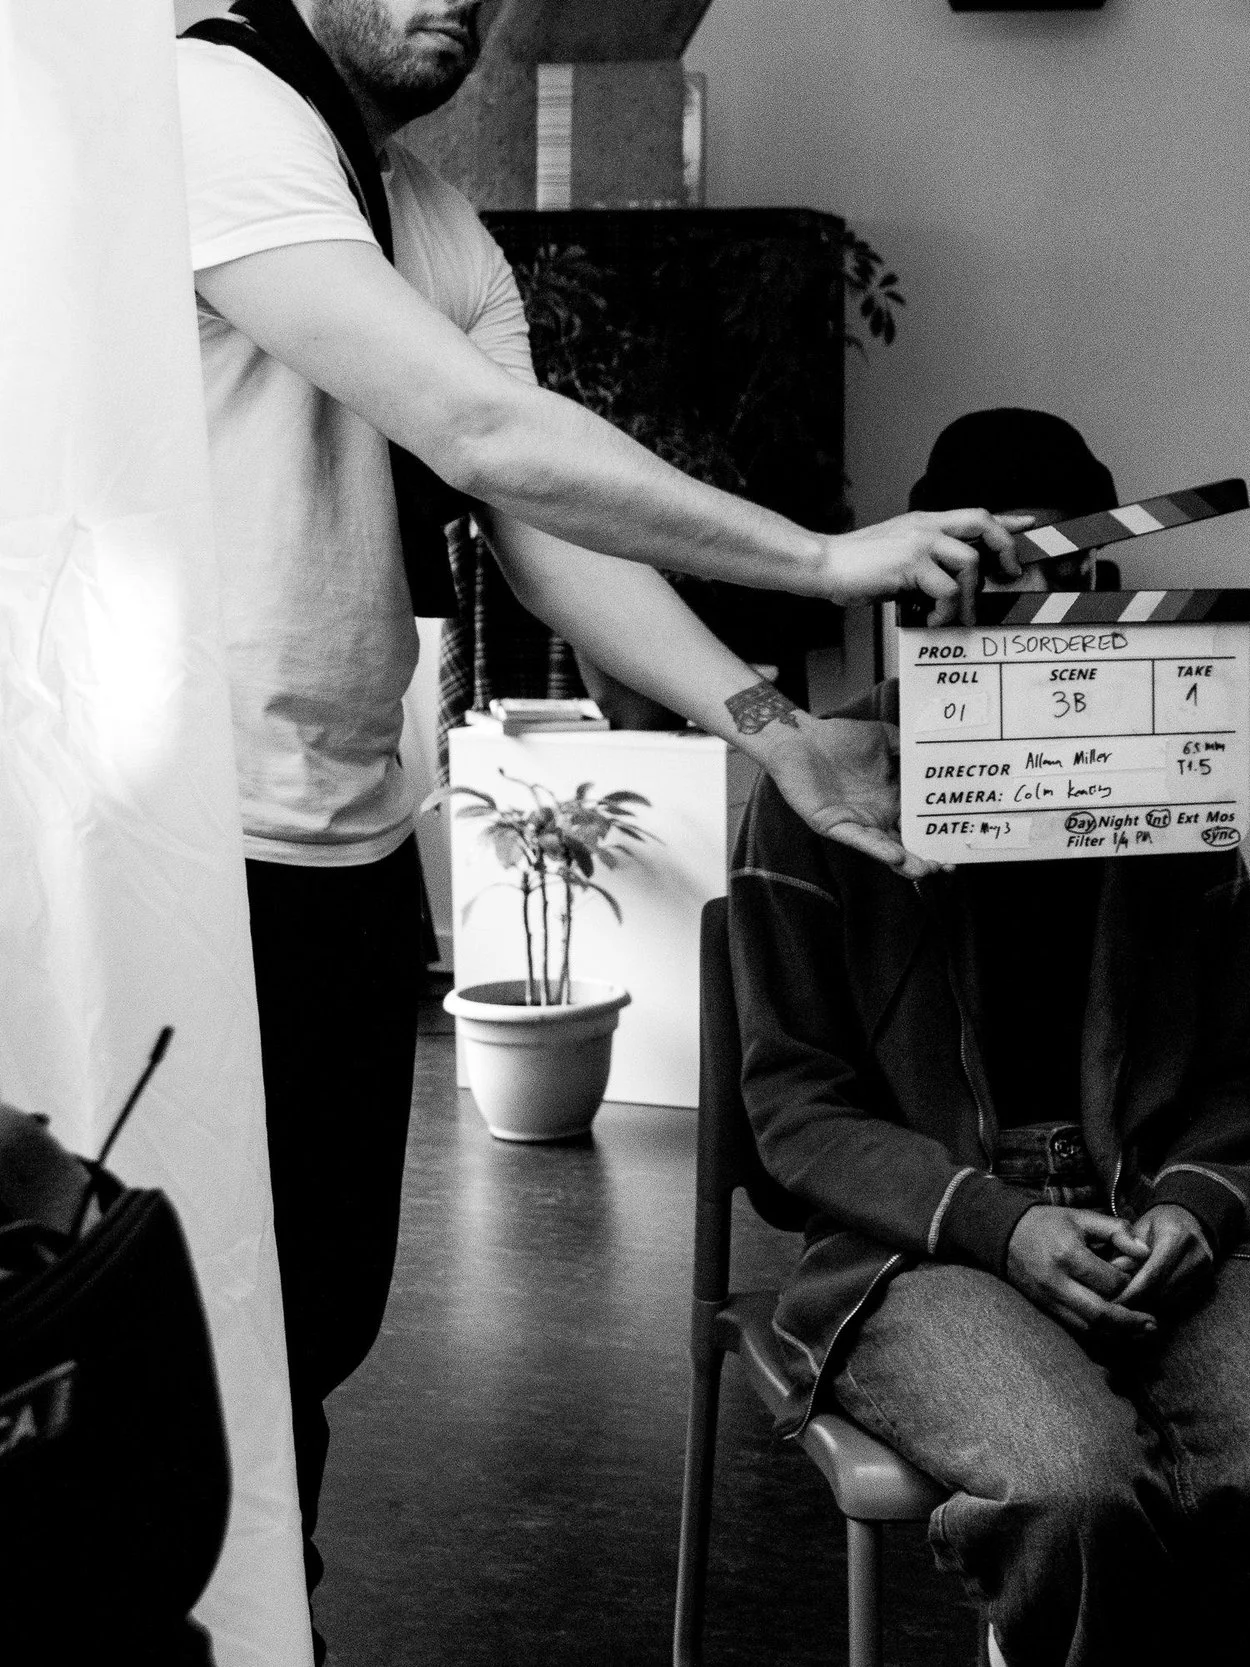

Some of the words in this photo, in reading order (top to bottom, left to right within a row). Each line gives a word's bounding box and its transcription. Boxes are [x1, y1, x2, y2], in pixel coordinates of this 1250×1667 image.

[918, 645, 967, 659] PROD.
[981, 632, 1129, 657] DISORDERED
[937, 671, 979, 684] ROLL
[1050, 668, 1098, 682] SCENE
[1177, 665, 1213, 678] TAKE
[944, 703, 966, 722] 01
[1052, 691, 1087, 718] 3B
[1186, 682, 1198, 707] 1
[925, 763, 1011, 779] DIRECTOR
[1072, 748, 1113, 766] Miller
[925, 790, 1004, 805] CAMERA:
[925, 821, 976, 836] DATE:
[1003, 821, 1012, 834] 3
[1065, 816, 1096, 832] Day
[1098, 815, 1140, 831] Night
[1147, 813, 1169, 825] Int
[1177, 812, 1200, 824] Ext
[1206, 810, 1236, 823] Mos
[1067, 835, 1106, 848] Filter
[1203, 829, 1239, 844] Sync
